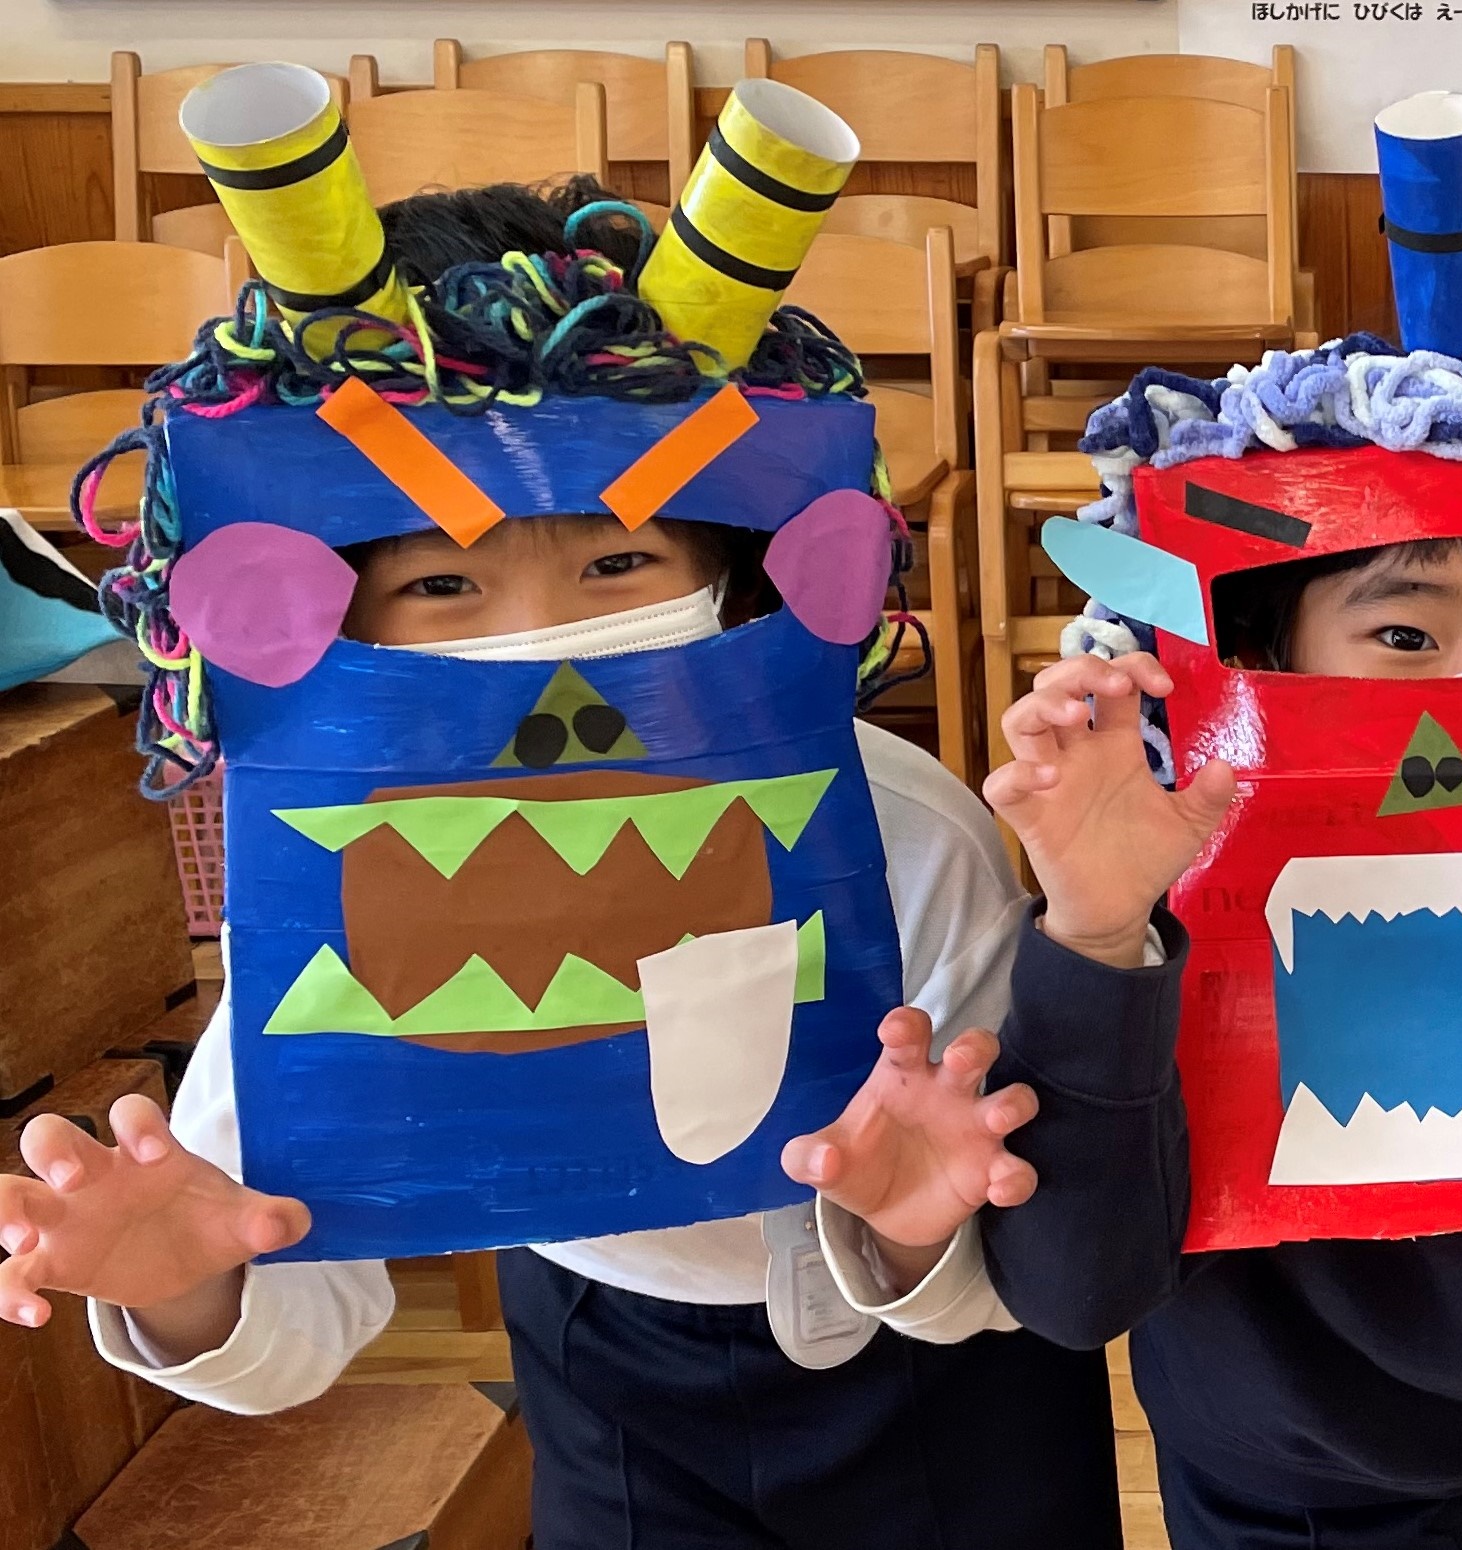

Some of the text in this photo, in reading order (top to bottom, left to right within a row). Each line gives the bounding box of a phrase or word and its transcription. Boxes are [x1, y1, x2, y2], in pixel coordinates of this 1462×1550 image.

[1252, 2, 1340, 21] ほしかげに
[1353, 2, 1423, 21] ひびくは
